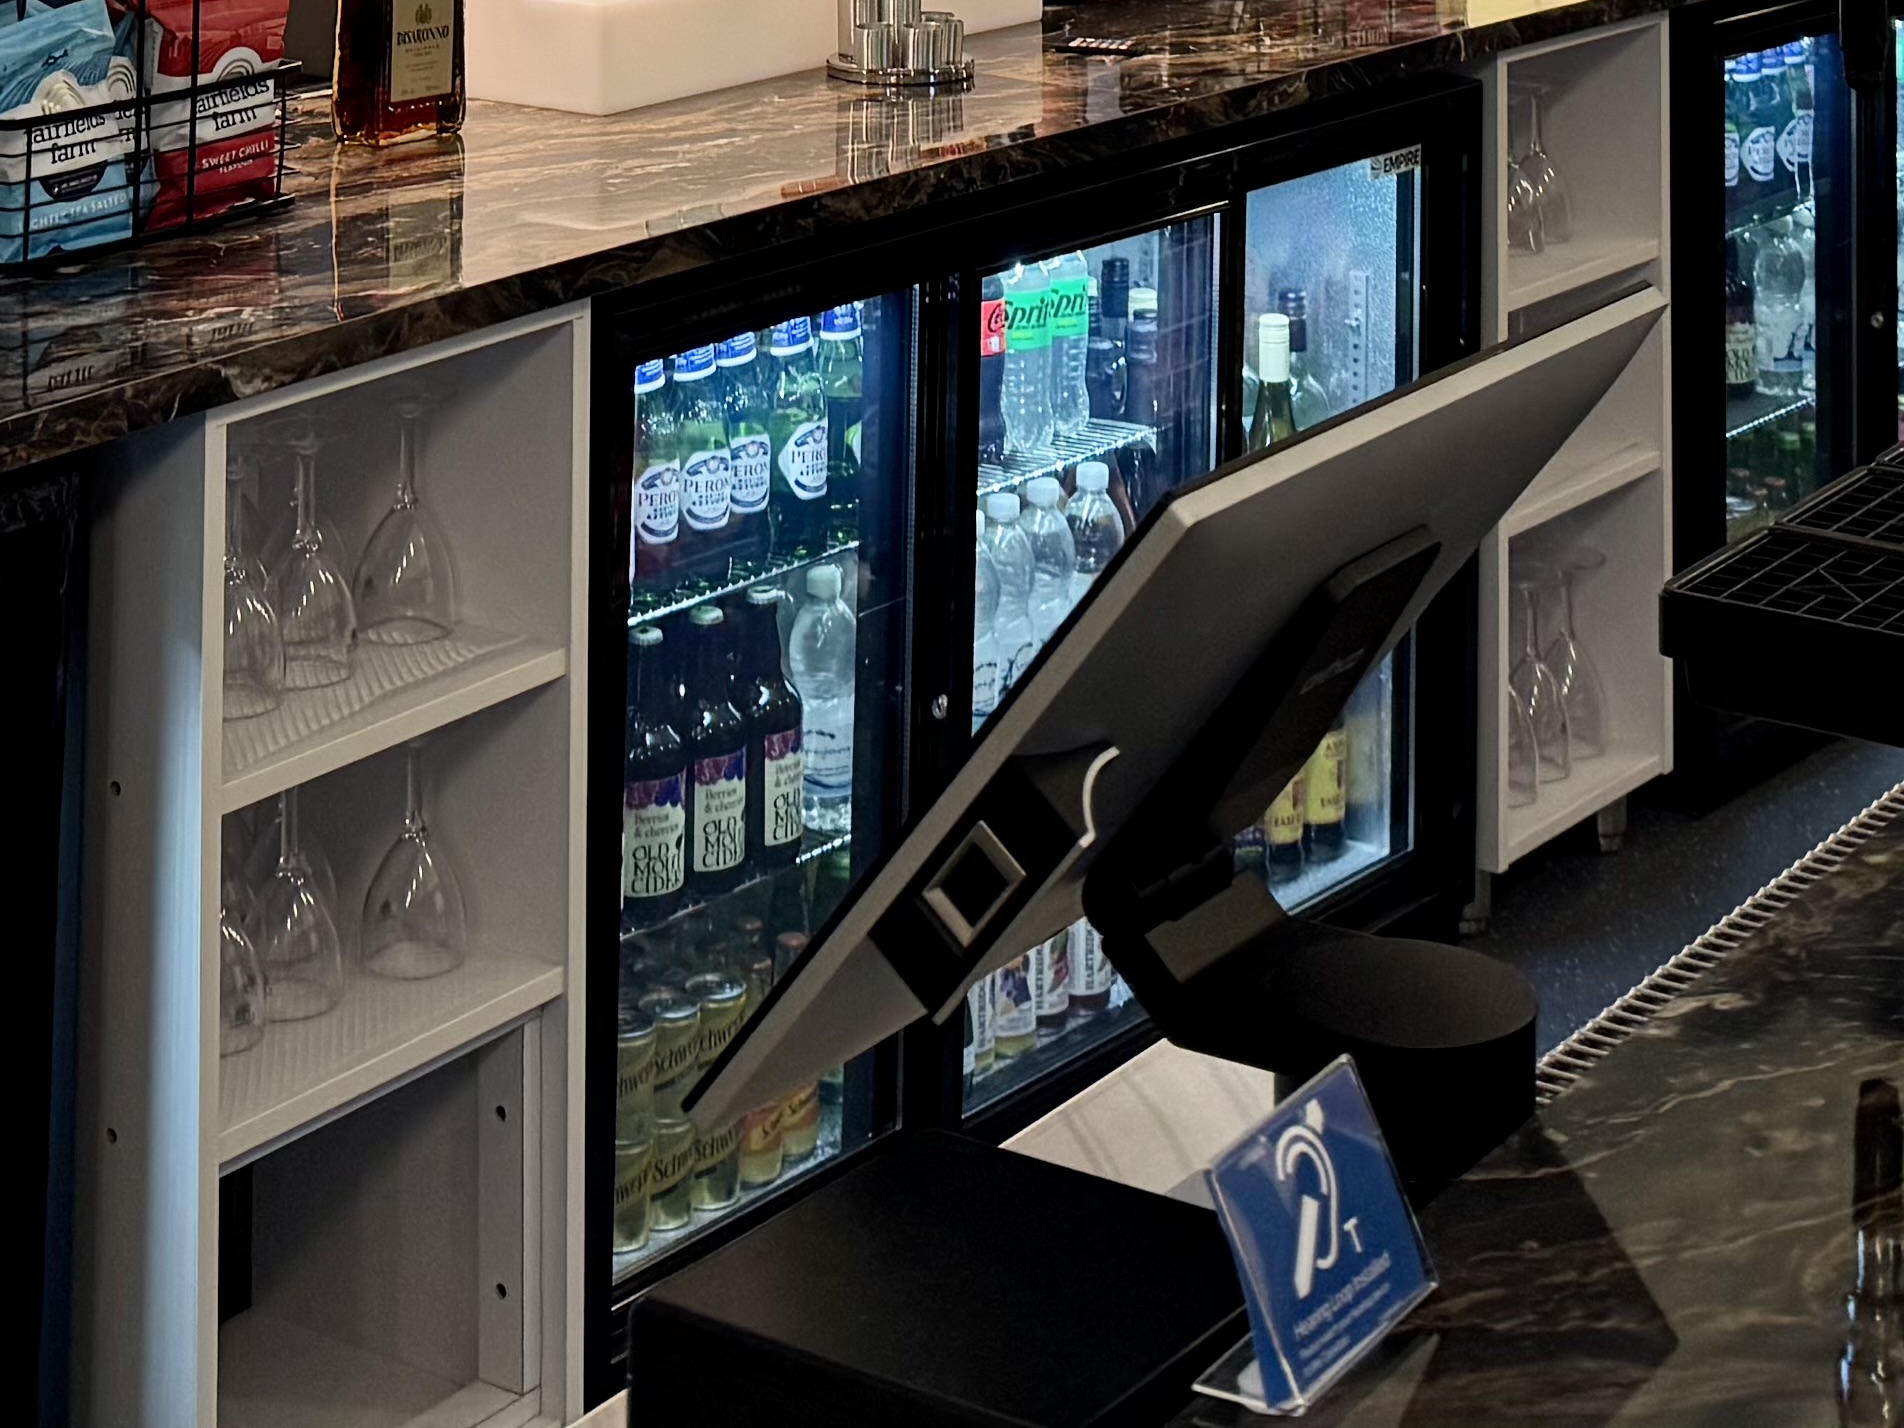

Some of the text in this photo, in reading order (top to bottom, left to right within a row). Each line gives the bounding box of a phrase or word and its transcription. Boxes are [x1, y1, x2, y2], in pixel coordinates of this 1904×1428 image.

[703, 816, 736, 838] OLD
[633, 842, 670, 863] OLD
[1344, 1216, 1363, 1253] T
